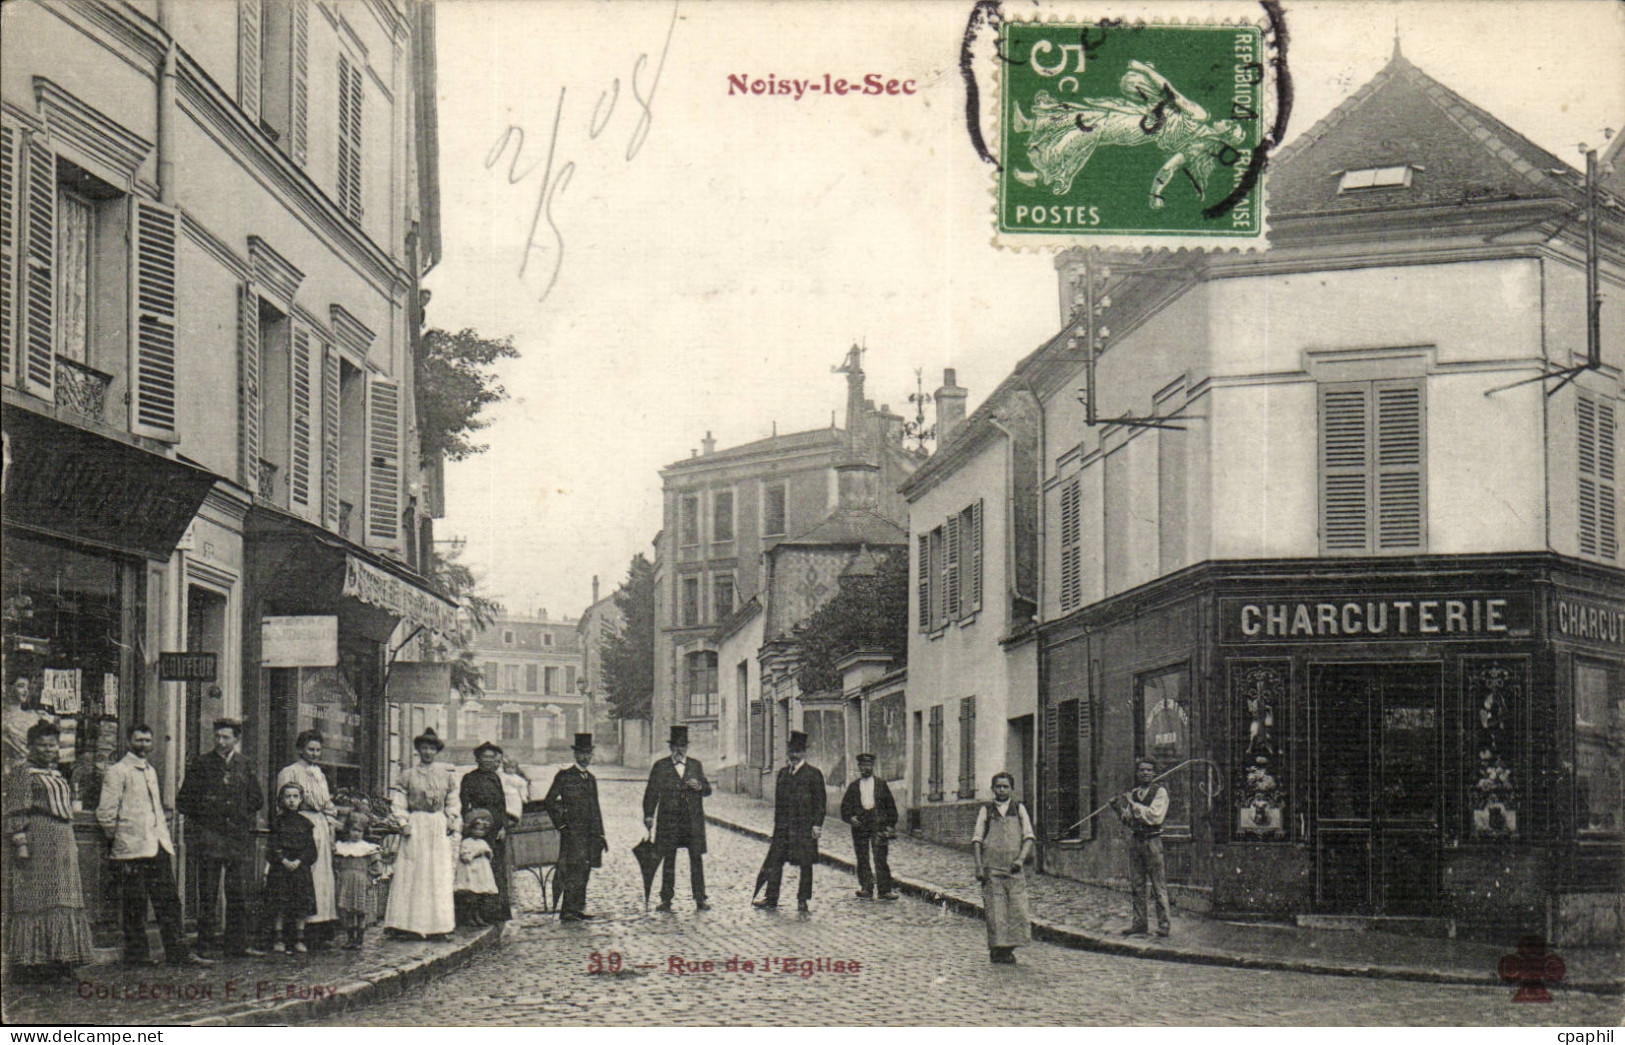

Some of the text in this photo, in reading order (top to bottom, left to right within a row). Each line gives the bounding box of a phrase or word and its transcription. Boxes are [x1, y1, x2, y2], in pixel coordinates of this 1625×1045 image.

[1015, 205, 1101, 226] POSTES
[1240, 599, 1508, 636] CHARCUTERIE
[161, 654, 215, 678] COIFFEUR
